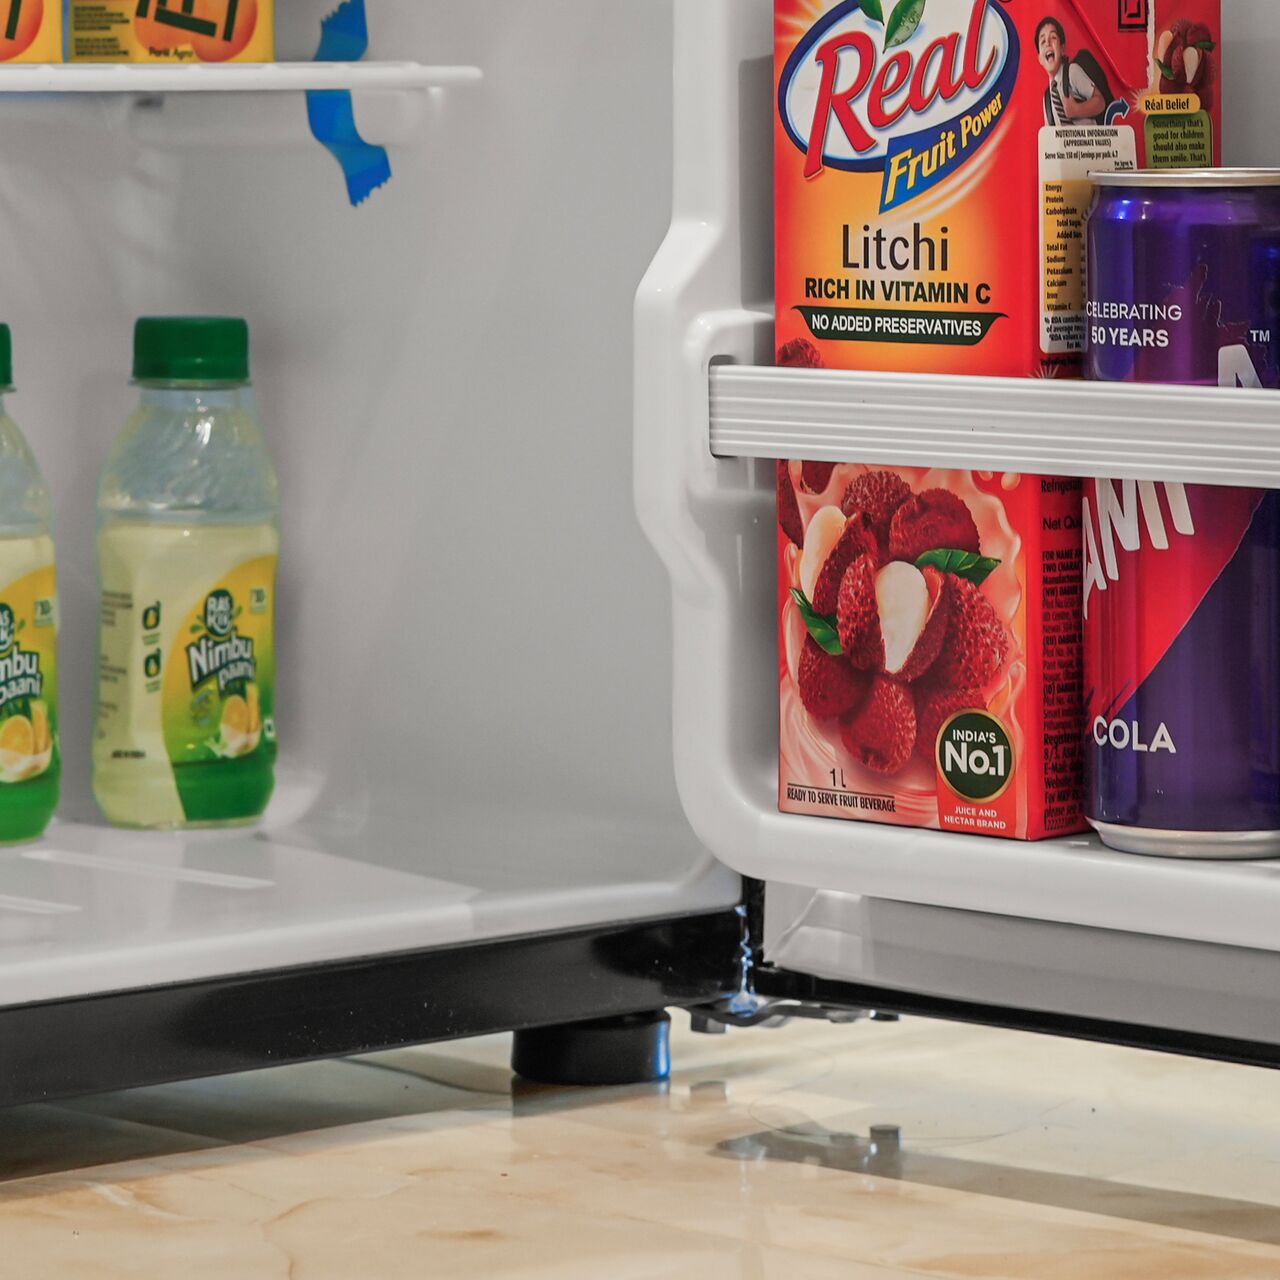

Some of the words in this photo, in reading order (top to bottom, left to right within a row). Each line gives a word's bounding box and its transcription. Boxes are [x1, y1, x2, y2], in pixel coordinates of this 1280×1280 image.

[1165, 98, 1190, 110] Belief
[1087, 128, 1119, 137] INFORMATION
[1153, 130, 1168, 142] good
[1170, 130, 1179, 139] for
[1180, 130, 1204, 139] children
[884, 131, 956, 205] Fruit
[960, 91, 1003, 148] Power
[1153, 142, 1174, 151] should
[1175, 142, 1187, 151] also
[1189, 141, 1205, 150] make
[1153, 153, 1169, 163] them
[1046, 184, 1062, 193] Energy
[1046, 195, 1064, 203] Protein
[1046, 207, 1077, 216] Carbohydrate
[842, 222, 949, 271] Litchi
[805, 277, 850, 300] RICH
[855, 279, 875, 301] IN
[881, 280, 969, 304] VITAMIN
[975, 283, 991, 304] C
[1047, 303, 1068, 311] Vitamin
[1086, 300, 1183, 322] CELEBRATING
[812, 314, 829, 330] NO
[831, 314, 871, 332] ADDED
[875, 316, 982, 336] PRESERVATIVES
[1091, 327, 1106, 345] 50
[1108, 327, 1169, 348] YEARS
[1250, 329, 1270, 343] TM
[1042, 517, 1061, 530] Net
[188, 630, 252, 684] Nimbu
[952, 729, 996, 744] INDIA'S
[1093, 714, 1176, 754] COLA
[945, 740, 1005, 777] No.1
[787, 787, 807, 802] READY
[808, 789, 817, 803] TO
[818, 790, 838, 806] SERVE
[839, 793, 858, 808] FRUIT
[860, 796, 896, 813] BEVERAGE
[955, 805, 977, 817] JUICE
[979, 807, 997, 818] AND
[944, 815, 975, 827] NECTAR
[977, 817, 1006, 830] BRAND
